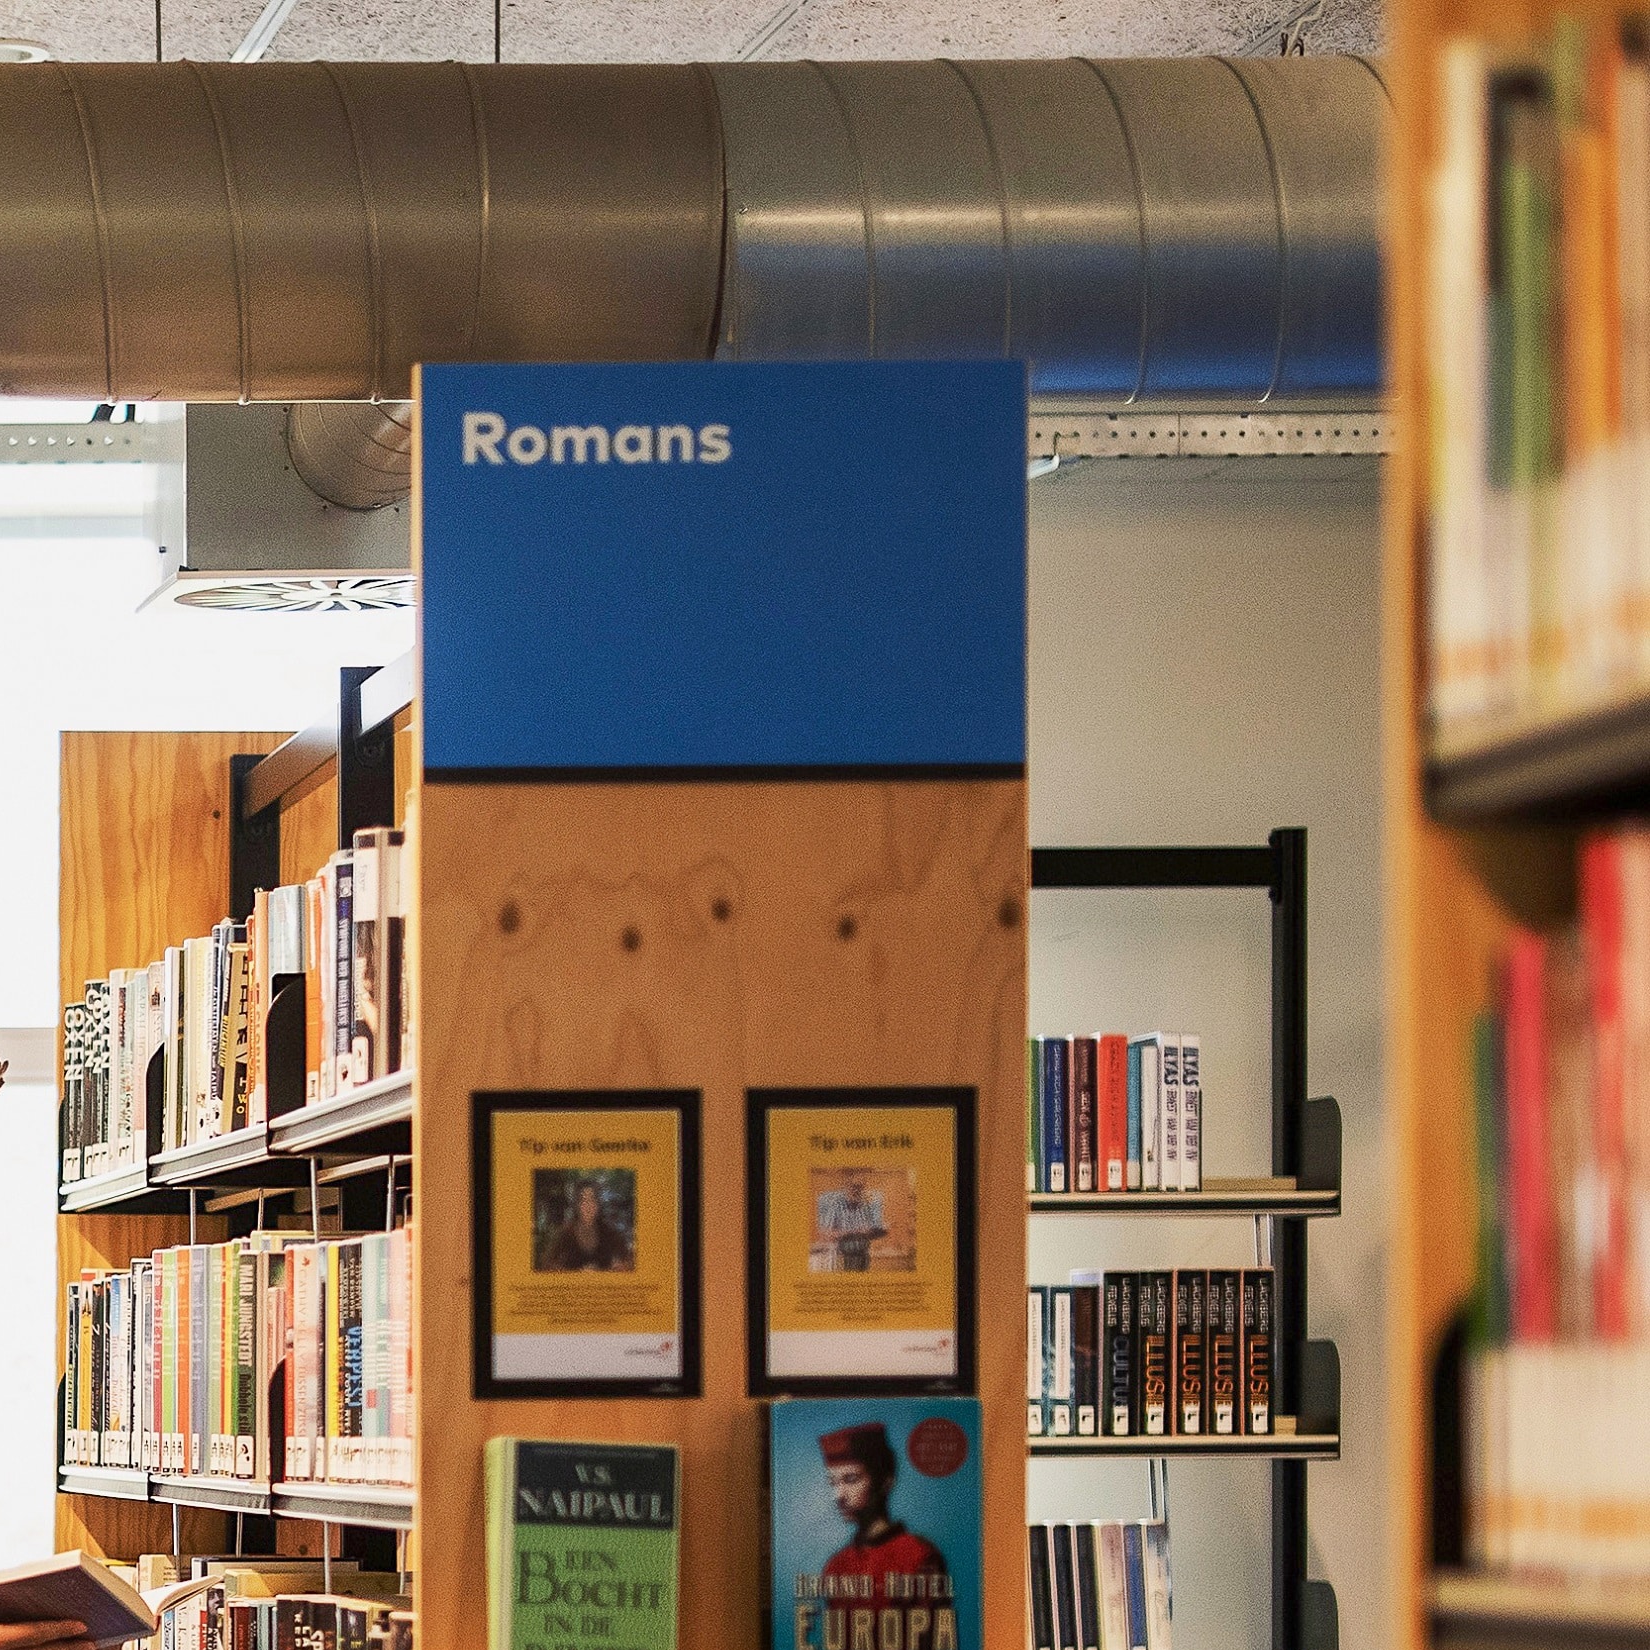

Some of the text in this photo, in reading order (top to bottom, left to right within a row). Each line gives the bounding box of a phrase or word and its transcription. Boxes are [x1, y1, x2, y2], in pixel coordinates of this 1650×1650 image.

[462, 410, 732, 465] Romans
[518, 1488, 670, 1522] NAIPAUL
[518, 1550, 663, 1610] BOCHT
[544, 1612, 613, 1637] IN DE
